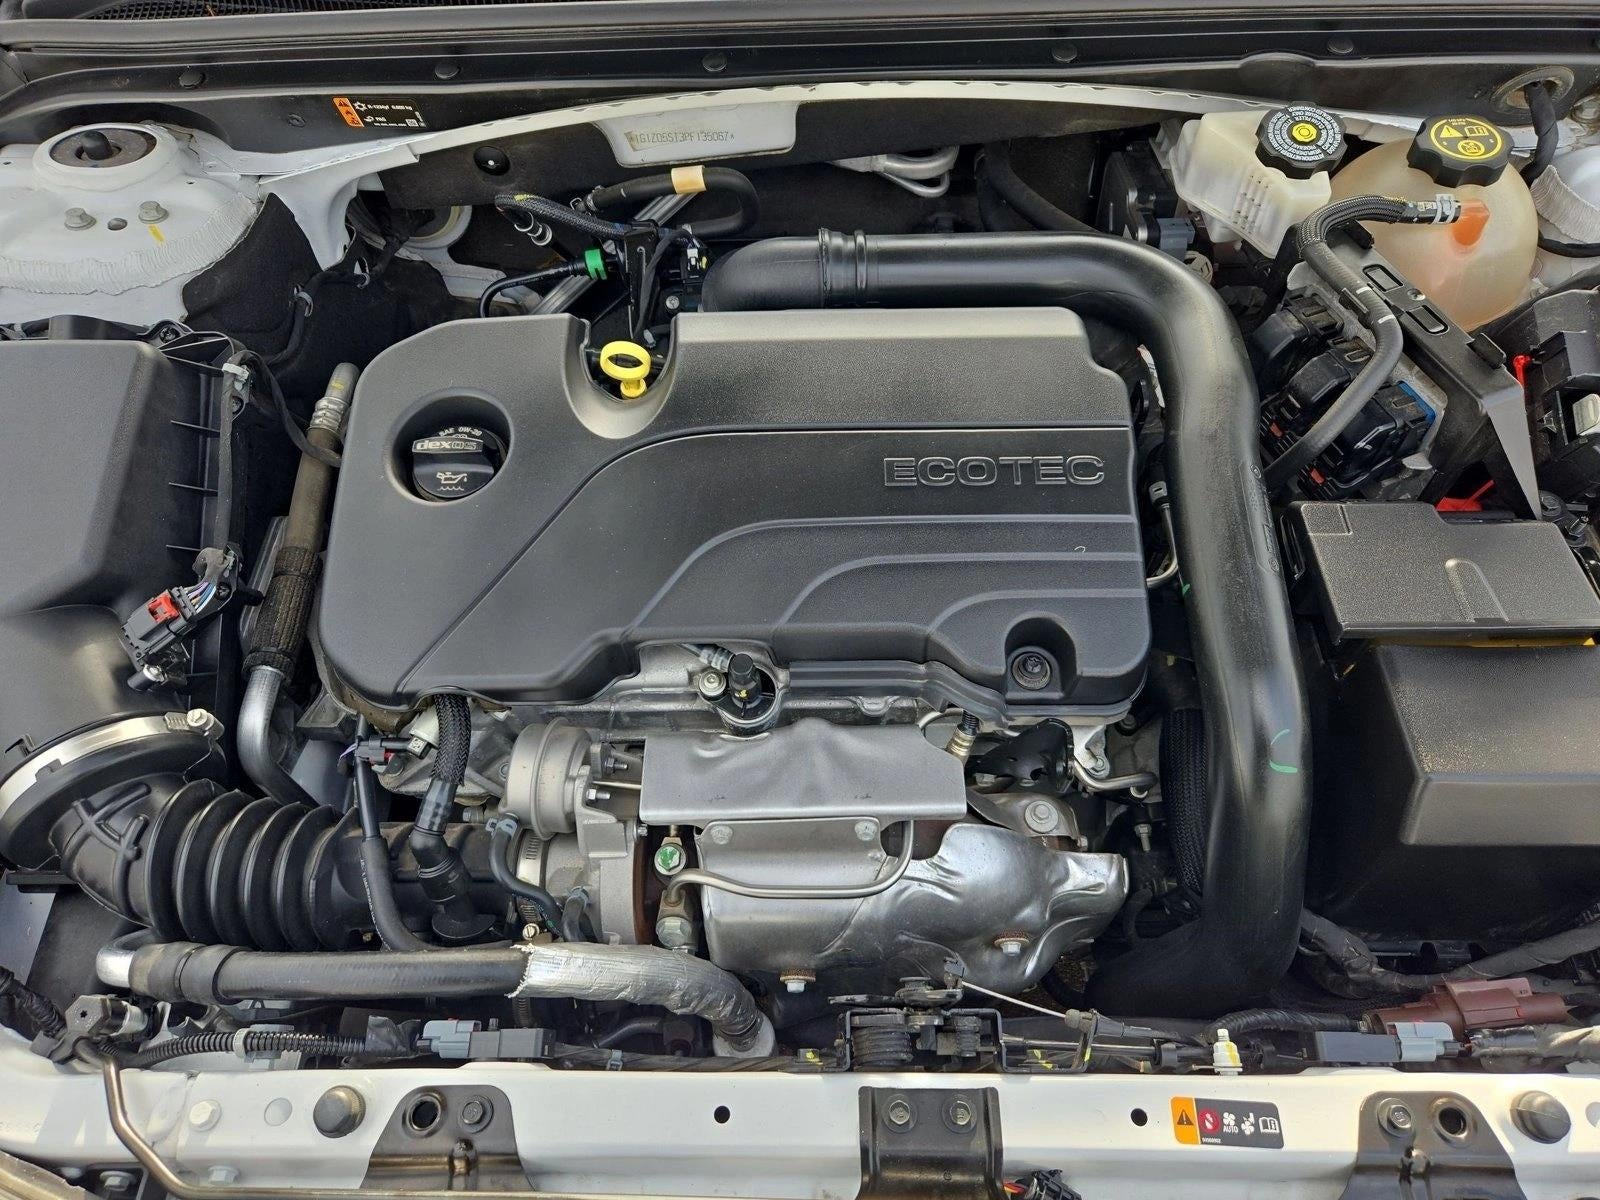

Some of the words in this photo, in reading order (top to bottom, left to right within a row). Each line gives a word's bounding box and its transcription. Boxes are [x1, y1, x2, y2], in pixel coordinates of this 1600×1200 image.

[458, 426, 482, 437] 0W-20
[884, 455, 1105, 487] ECOTEC
[1223, 1125, 1239, 1134] AUTO
